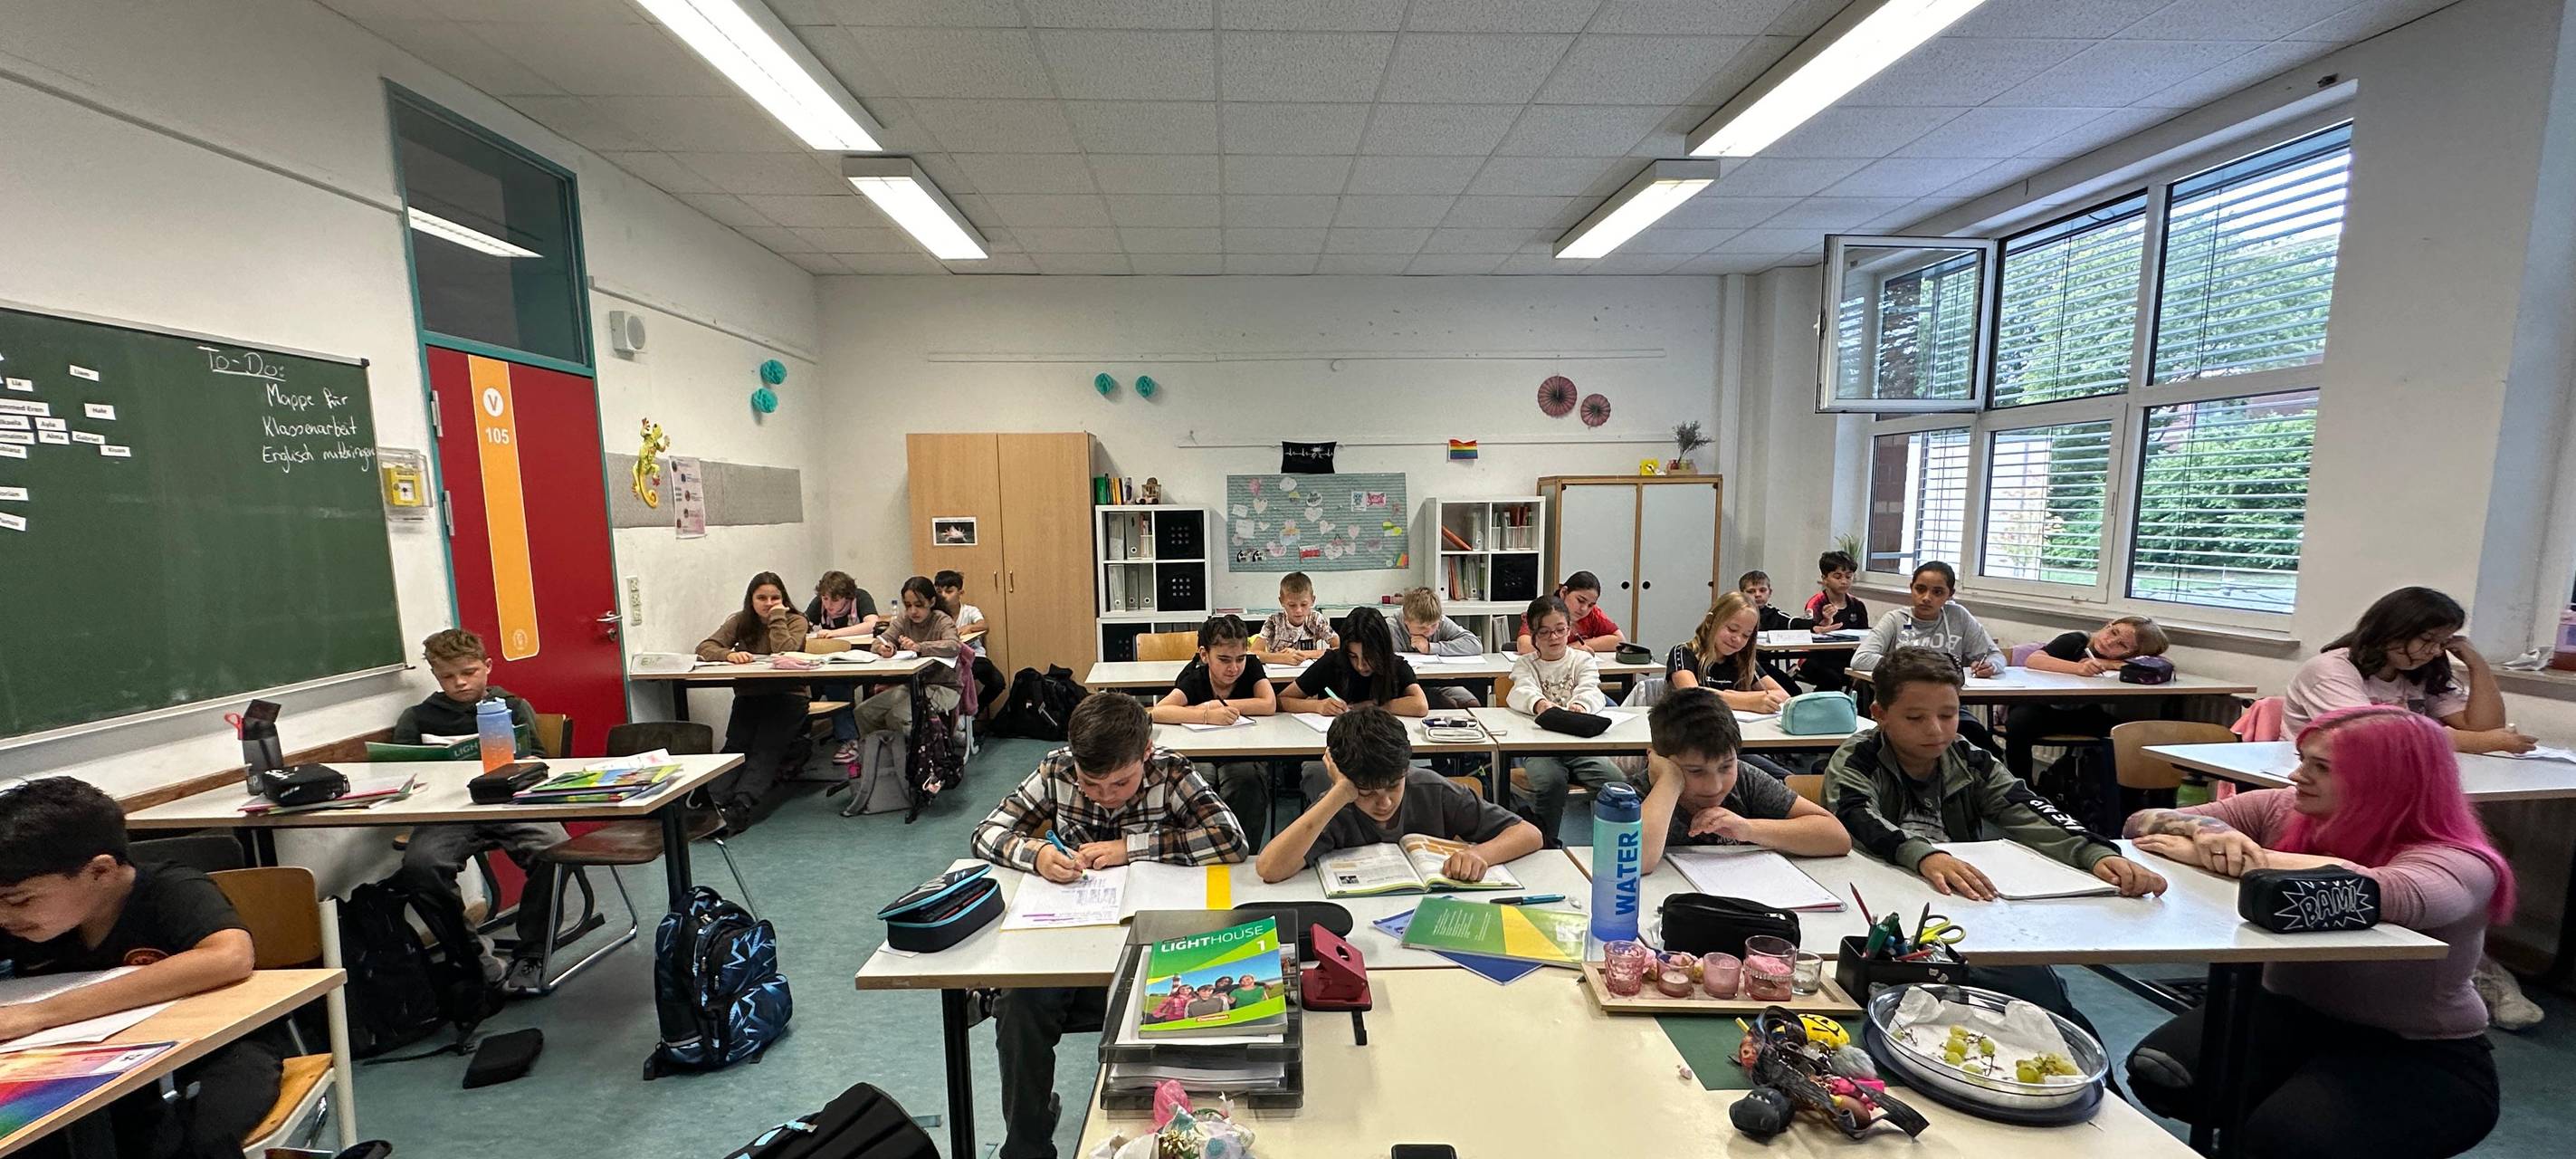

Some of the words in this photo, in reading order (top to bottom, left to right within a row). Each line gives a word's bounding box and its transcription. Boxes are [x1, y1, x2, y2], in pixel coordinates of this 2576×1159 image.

[197, 346, 285, 378] To-Do:
[266, 383, 314, 411] Mappe
[323, 388, 348, 408] für
[487, 394, 499, 411] V
[262, 416, 357, 436] Klassenarbeit
[485, 426, 510, 445] 105
[262, 444, 314, 473] Englisch
[1615, 830, 1639, 915] WATER
[2299, 885, 2358, 928] BAM!
[1160, 924, 1264, 953] LIGHTHOUSE
[1256, 940, 1266, 952] 1
